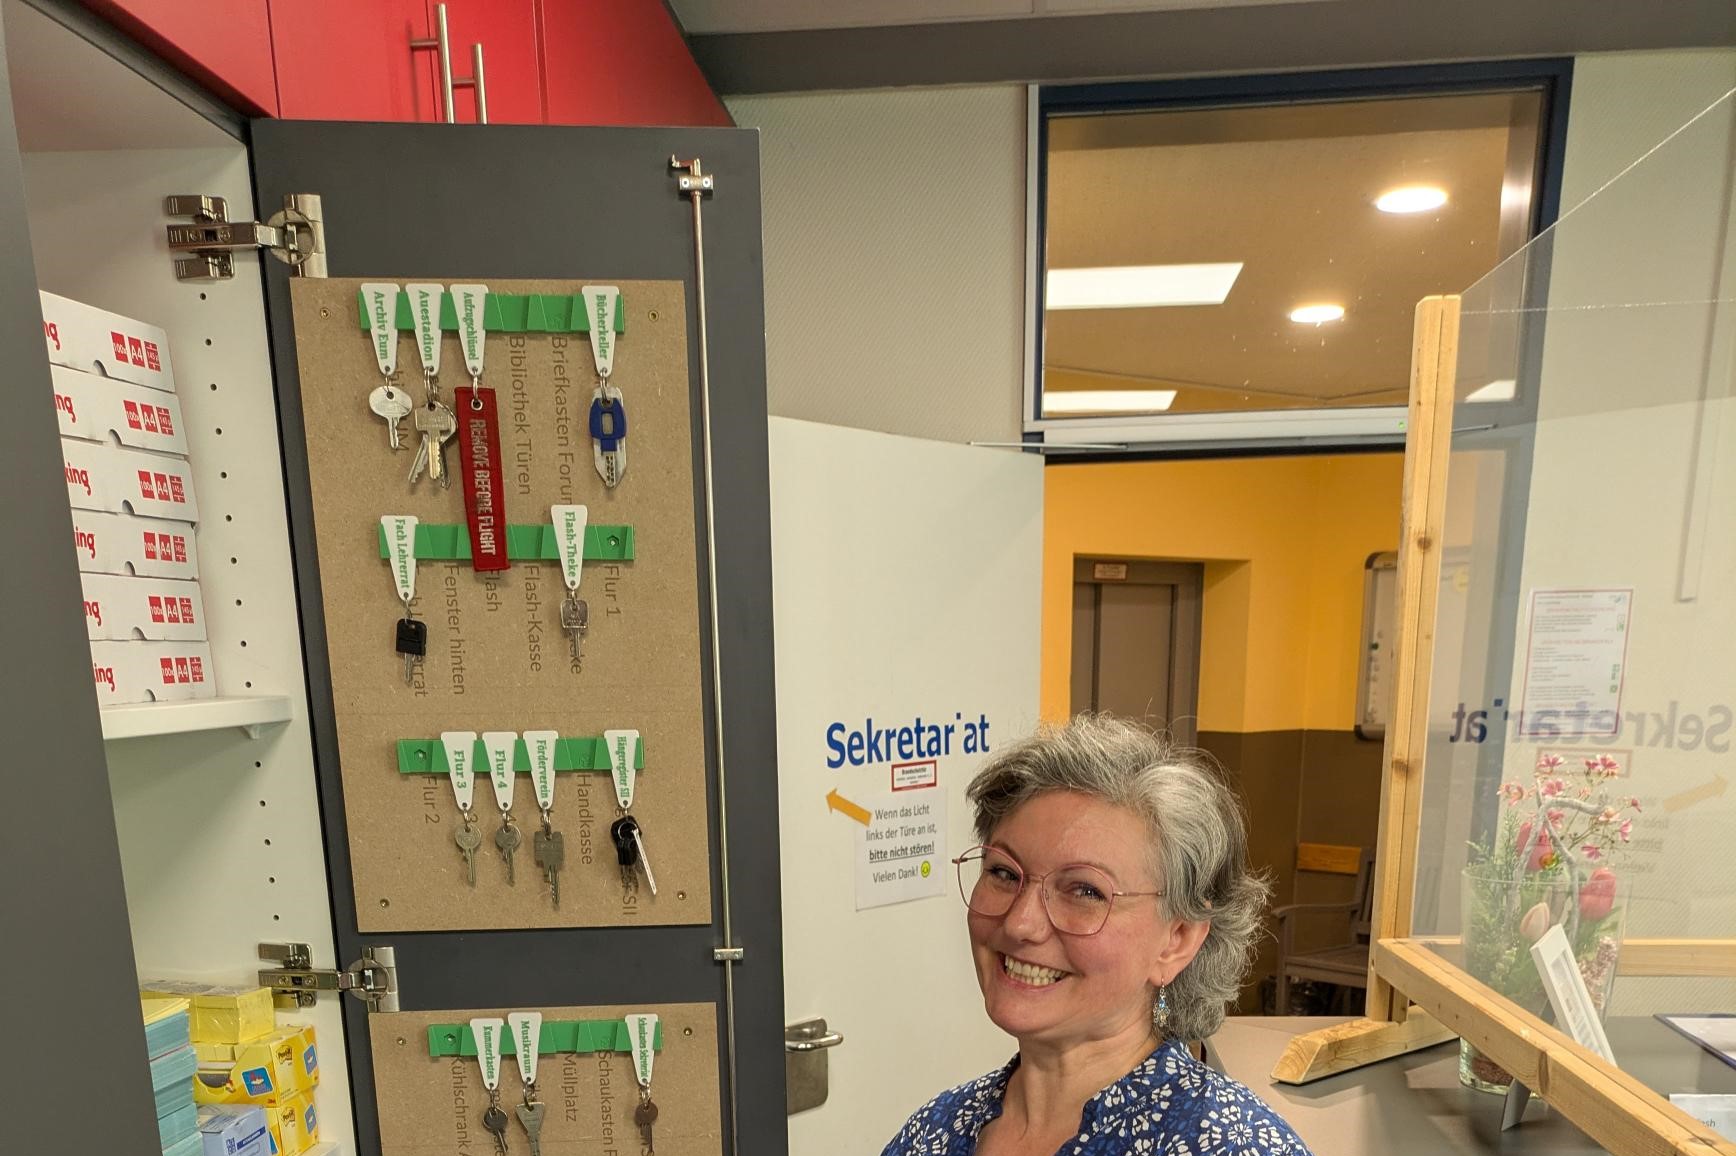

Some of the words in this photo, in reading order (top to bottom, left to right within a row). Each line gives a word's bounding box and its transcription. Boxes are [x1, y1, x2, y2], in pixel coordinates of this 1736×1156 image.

[373, 291, 388, 332] Archiv
[418, 290, 433, 361] Auestadion
[462, 291, 479, 361] Aufzugschlüssel
[596, 293, 609, 361] Bücherkeller
[131, 345, 143, 361] A4
[377, 334, 390, 360] Eum
[509, 336, 529, 434] Bibliothek
[551, 336, 571, 446] Briefkasten
[144, 411, 156, 427] A4
[469, 418, 490, 468] REMOVE
[515, 439, 533, 495] Türen
[157, 480, 169, 496] A4
[473, 469, 494, 513] BEFORE
[160, 541, 171, 556] A4
[395, 518, 408, 542] Fach
[478, 515, 497, 555] FLIGHT
[564, 511, 578, 578] Flash-Theke
[397, 543, 410, 589] Lehrerrat
[603, 565, 620, 602] Flur
[167, 604, 179, 618] A4
[443, 564, 461, 634] Fenster
[523, 565, 544, 673] Flash-Kasse
[606, 604, 622, 617] 1
[178, 665, 189, 677] A4
[449, 638, 466, 696] hinten
[826, 712, 991, 769] Sekretarat
[453, 750, 465, 777] Flur
[494, 750, 506, 777] Flur
[536, 740, 550, 799] Förderverein
[421, 775, 437, 809] Flur
[456, 781, 467, 789] 3
[498, 780, 508, 789] 4
[425, 814, 440, 824] 2
[575, 774, 594, 865] Handkasse
[866, 829, 883, 842] links
[885, 828, 898, 839] der
[900, 825, 916, 837] Türe
[917, 826, 926, 835] an
[927, 823, 937, 835] ist,
[875, 808, 898, 820] Wenn
[900, 806, 912, 817] das
[913, 805, 930, 817] Licht
[869, 848, 888, 861] bitte
[889, 845, 909, 858] nicht
[909, 841, 935, 856] stören!
[872, 869, 896, 883] Vielen
[898, 866, 919, 879] Dank!
[482, 1025, 495, 1080] Kummerkasten
[520, 1019, 533, 1074] Musikraum
[450, 1057, 471, 1149] Kühlschrank
[562, 1053, 580, 1122] Müllplatz
[598, 1050, 615, 1146] Schaukasten
